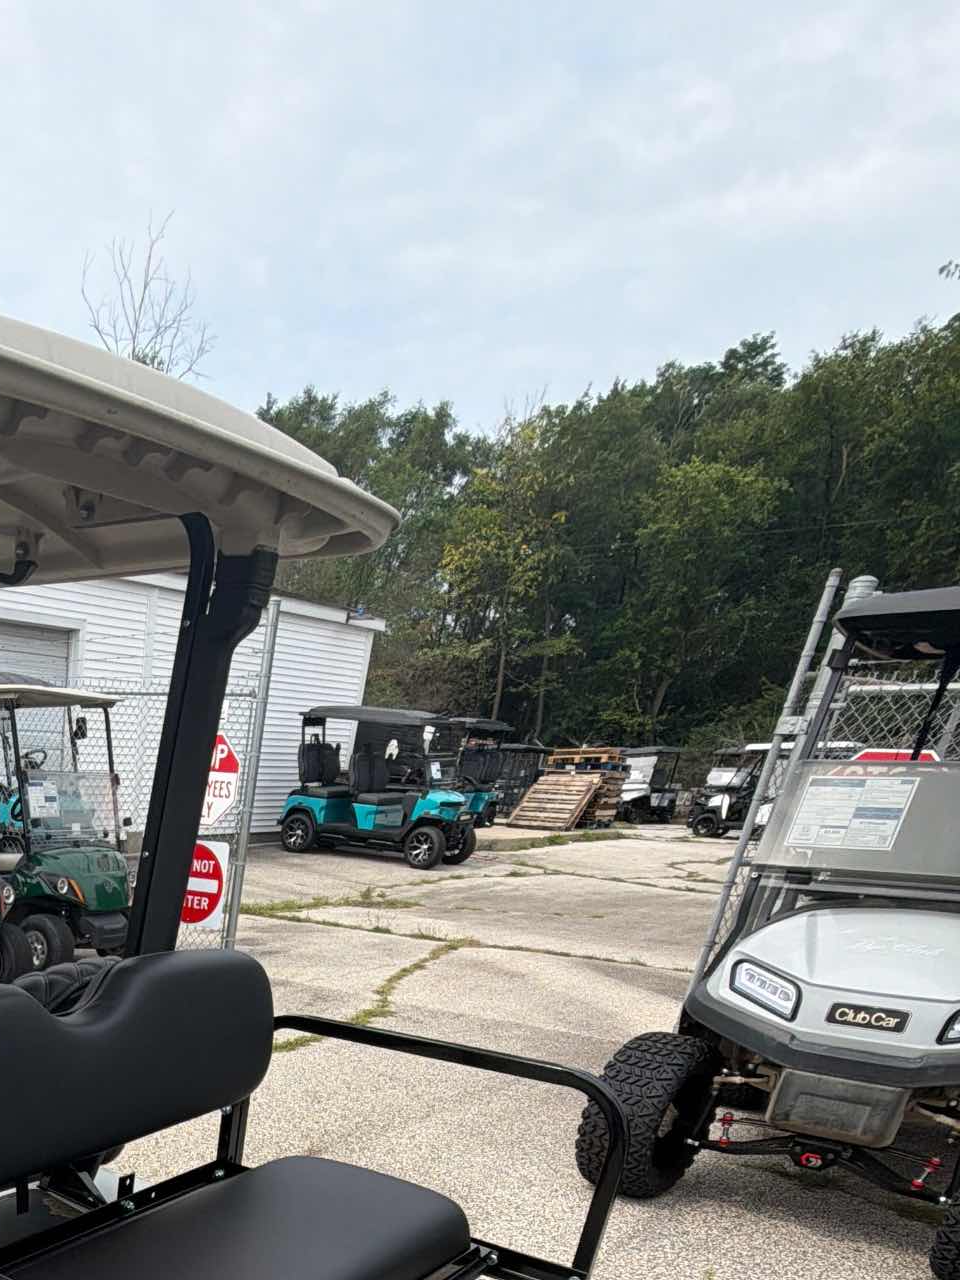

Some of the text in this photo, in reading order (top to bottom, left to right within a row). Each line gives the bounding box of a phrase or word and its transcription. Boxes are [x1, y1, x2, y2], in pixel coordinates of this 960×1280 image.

[208, 780, 232, 799] YEES
[193, 860, 215, 874] NOT
[835, 1007, 900, 1028] Club Car
